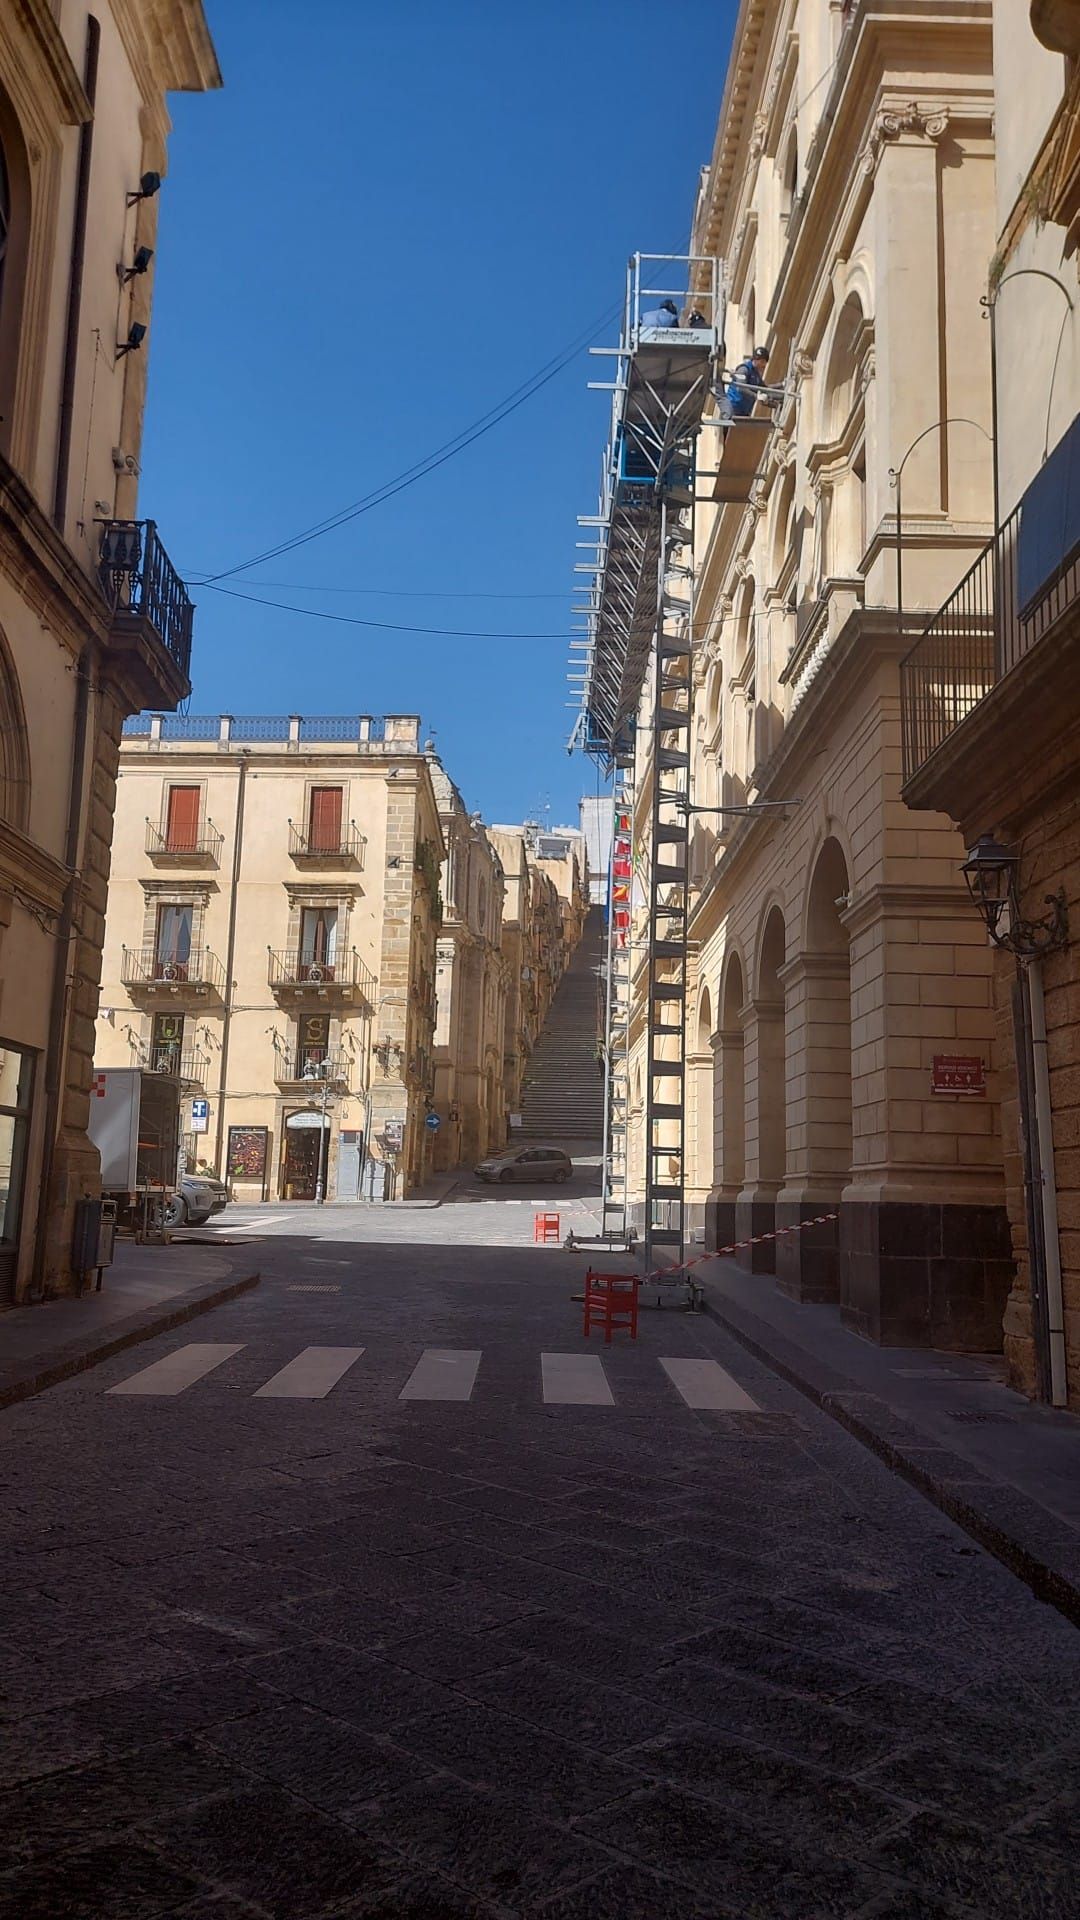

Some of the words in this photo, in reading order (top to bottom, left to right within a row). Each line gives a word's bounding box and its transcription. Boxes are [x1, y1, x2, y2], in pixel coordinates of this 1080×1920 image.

[159, 1016, 183, 1039] U
[306, 1017, 324, 1040] S
[194, 1101, 205, 1116] T
